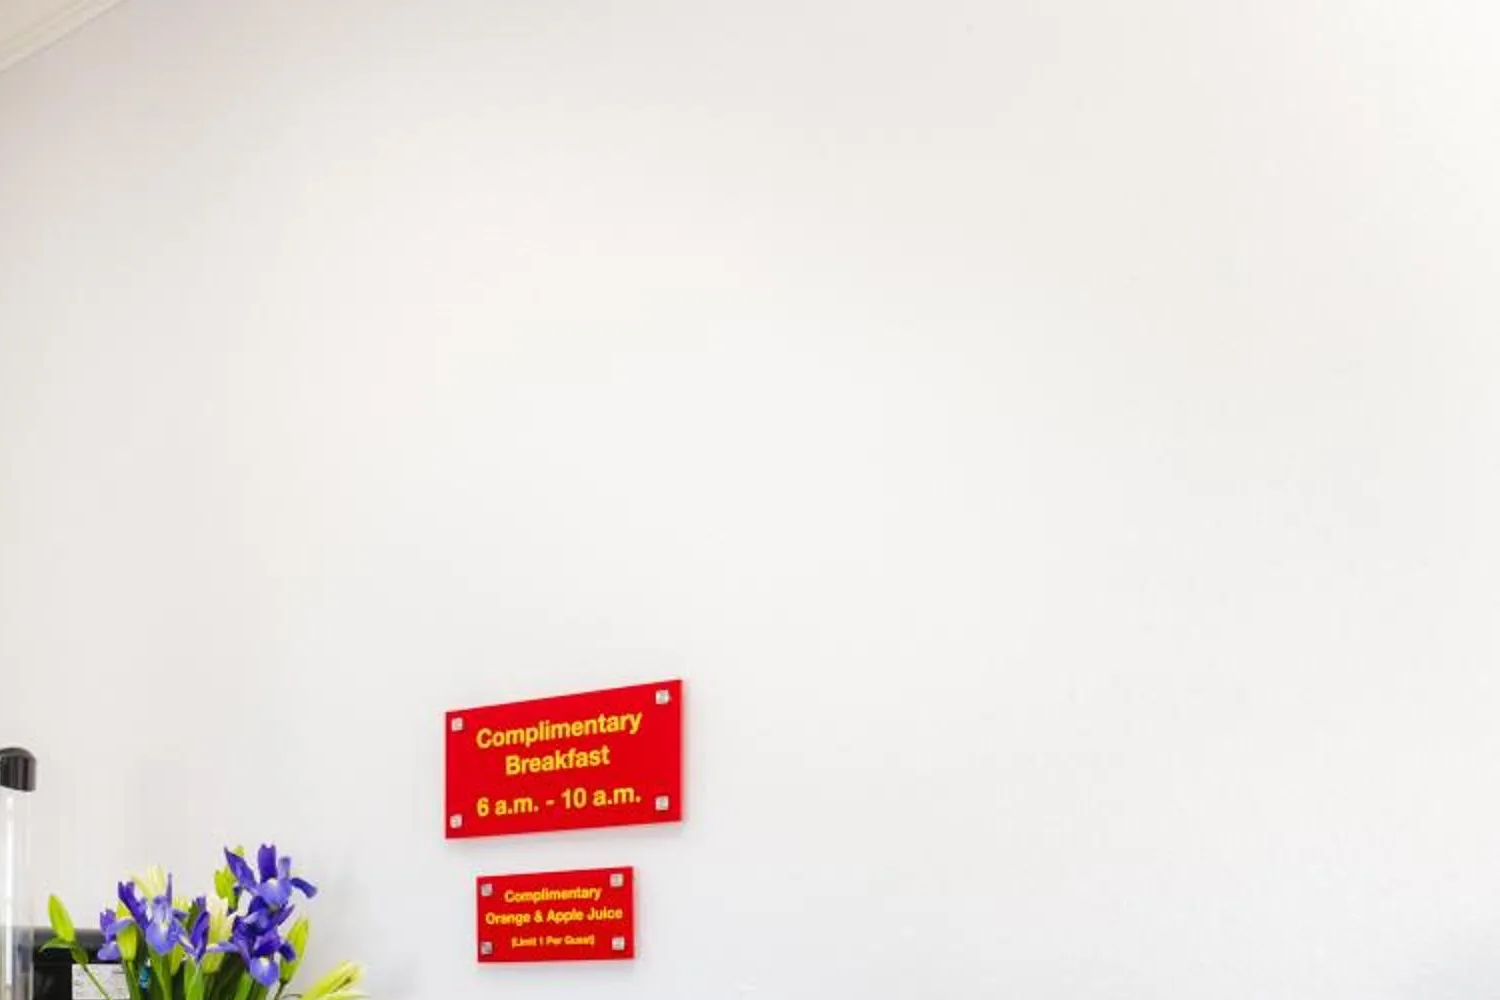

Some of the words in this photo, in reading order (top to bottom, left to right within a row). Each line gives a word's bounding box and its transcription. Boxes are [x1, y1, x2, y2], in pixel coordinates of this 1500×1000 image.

[476, 711, 643, 748] Complimentary
[505, 745, 610, 776] Breakfast
[476, 797, 489, 816] 6
[495, 797, 539, 815] a.m.
[561, 787, 587, 809] 10
[593, 786, 641, 805] a.m.
[504, 887, 602, 904] Complimentary
[485, 911, 531, 926] Orange
[534, 909, 543, 923] &
[546, 908, 584, 924] Apple
[587, 906, 623, 920] Juice
